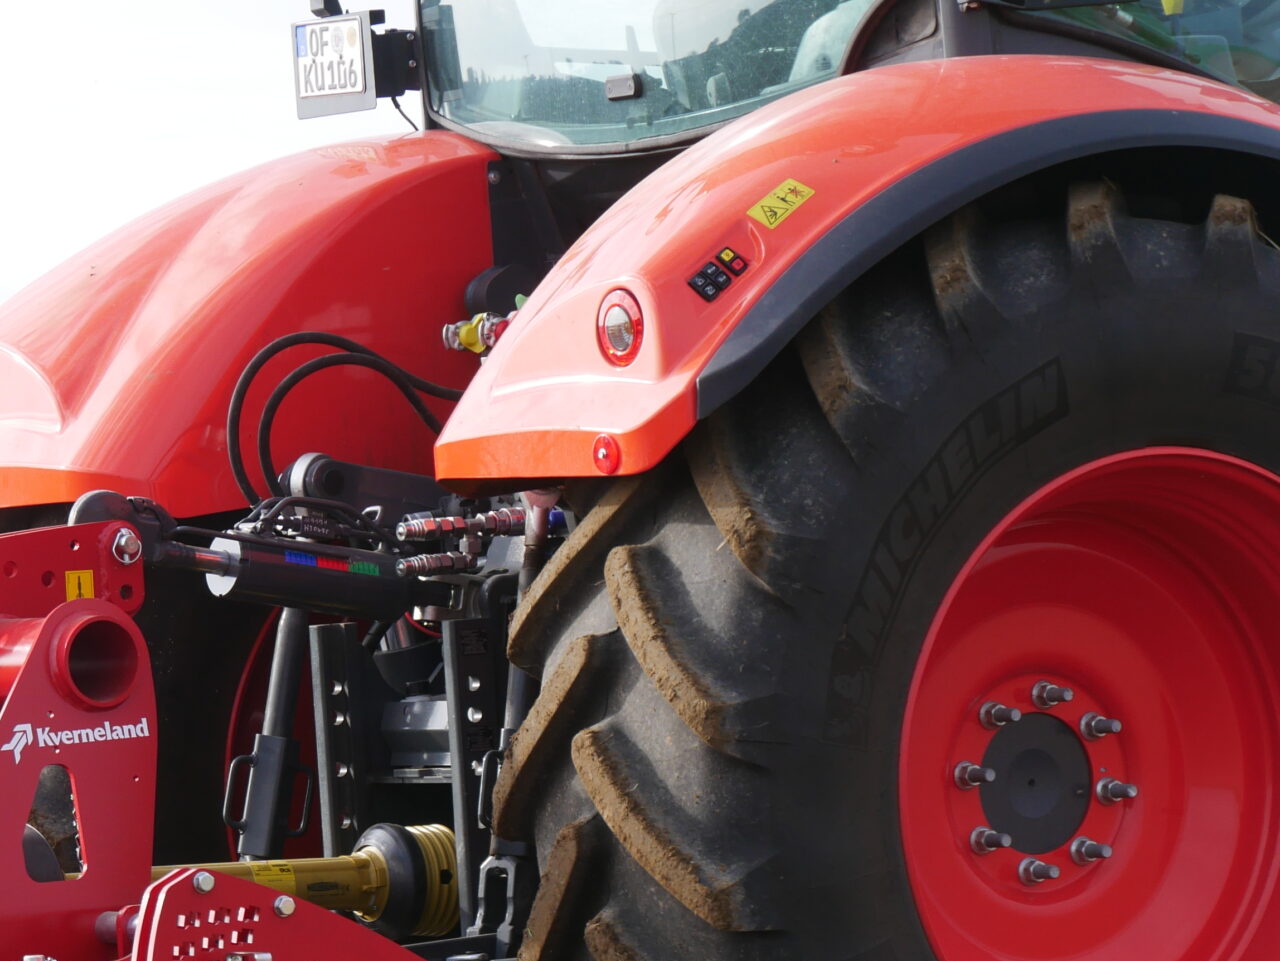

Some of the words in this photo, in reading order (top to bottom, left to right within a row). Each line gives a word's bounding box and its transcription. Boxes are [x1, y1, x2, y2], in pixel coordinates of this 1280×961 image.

[309, 26, 329, 57] OF
[845, 360, 1061, 658] MICHELIN
[36, 717, 150, 747] Kverneland
